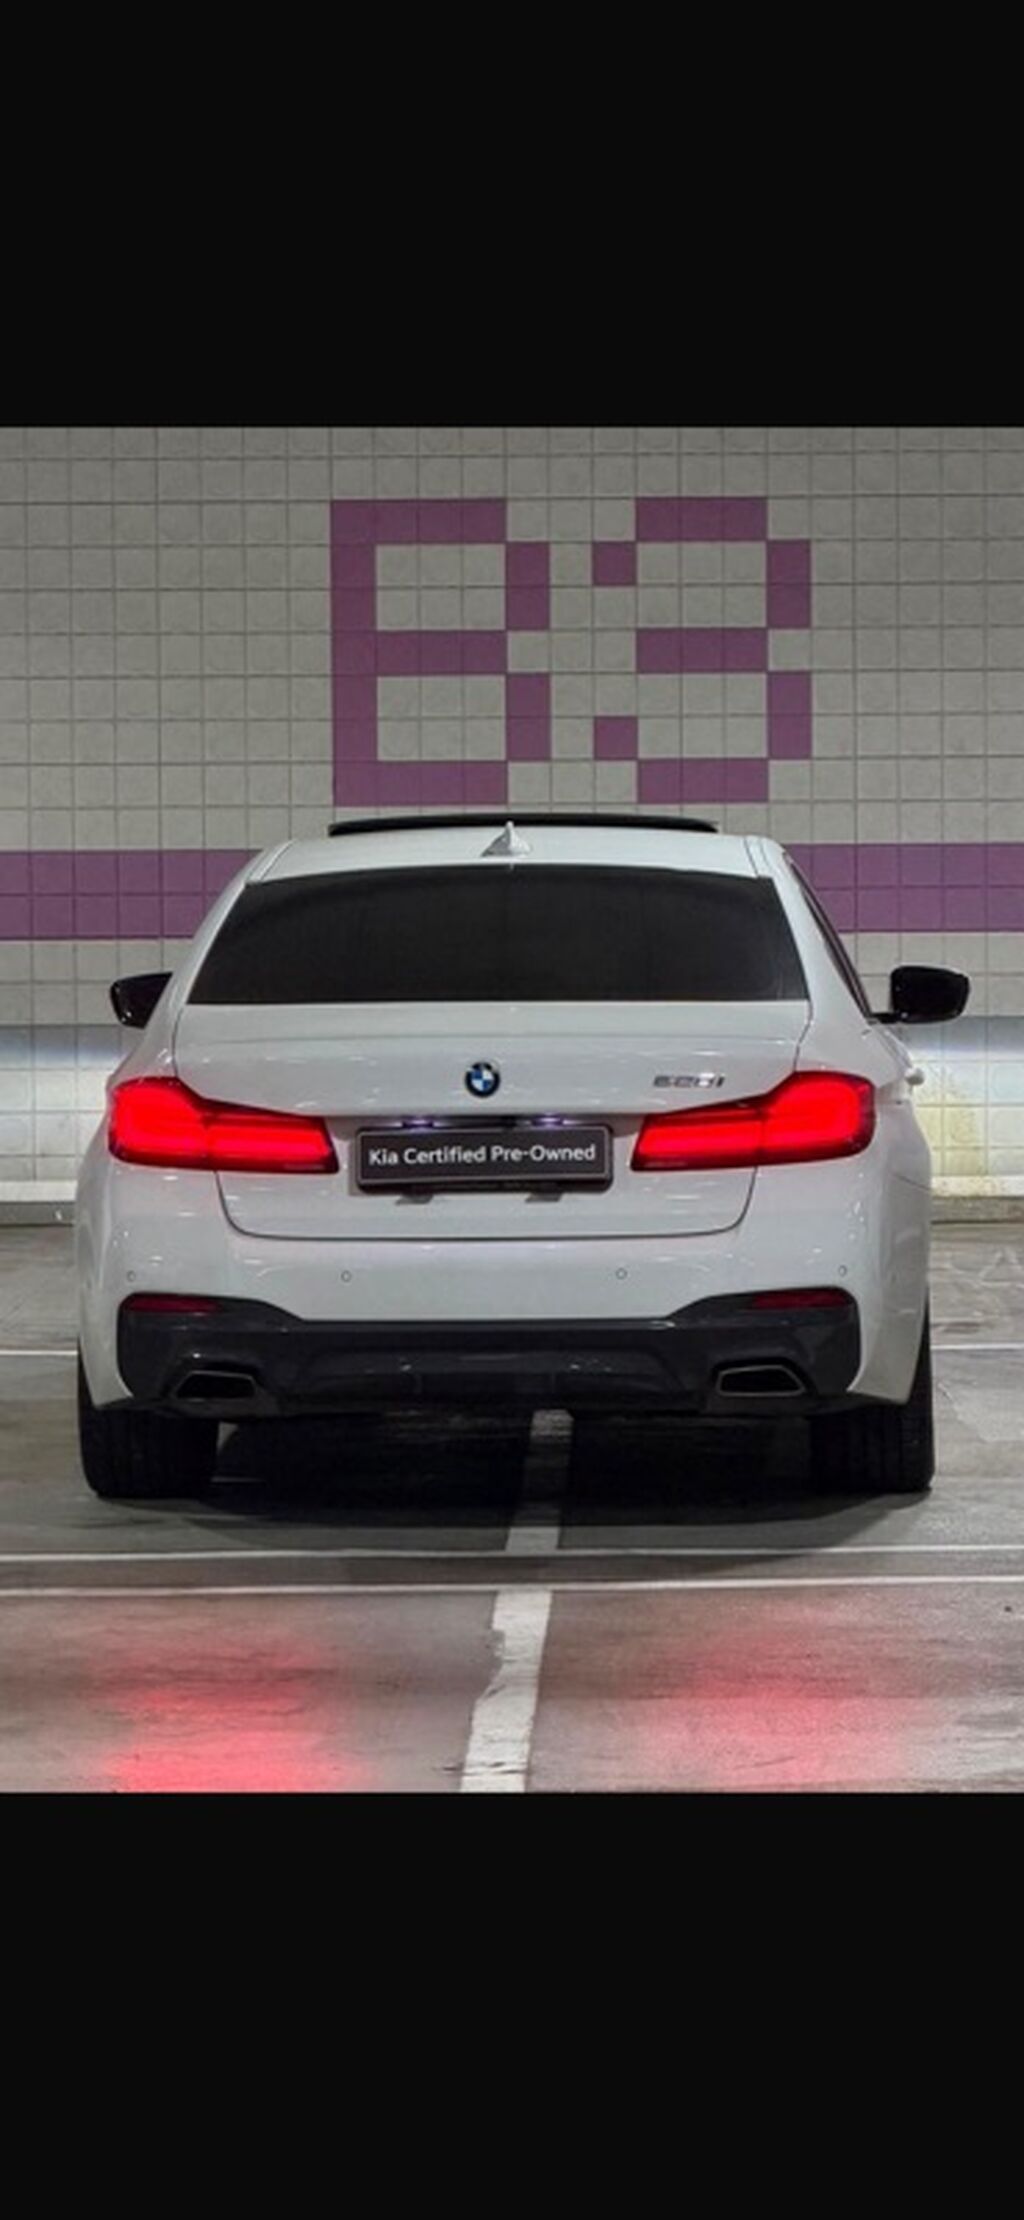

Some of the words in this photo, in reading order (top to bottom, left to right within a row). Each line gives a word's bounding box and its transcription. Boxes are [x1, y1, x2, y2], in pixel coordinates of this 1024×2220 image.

[331, 497, 812, 807] B3
[368, 1149, 399, 1165] Kia
[403, 1147, 487, 1164] Certified
[490, 1145, 595, 1161] Pre-Owned
